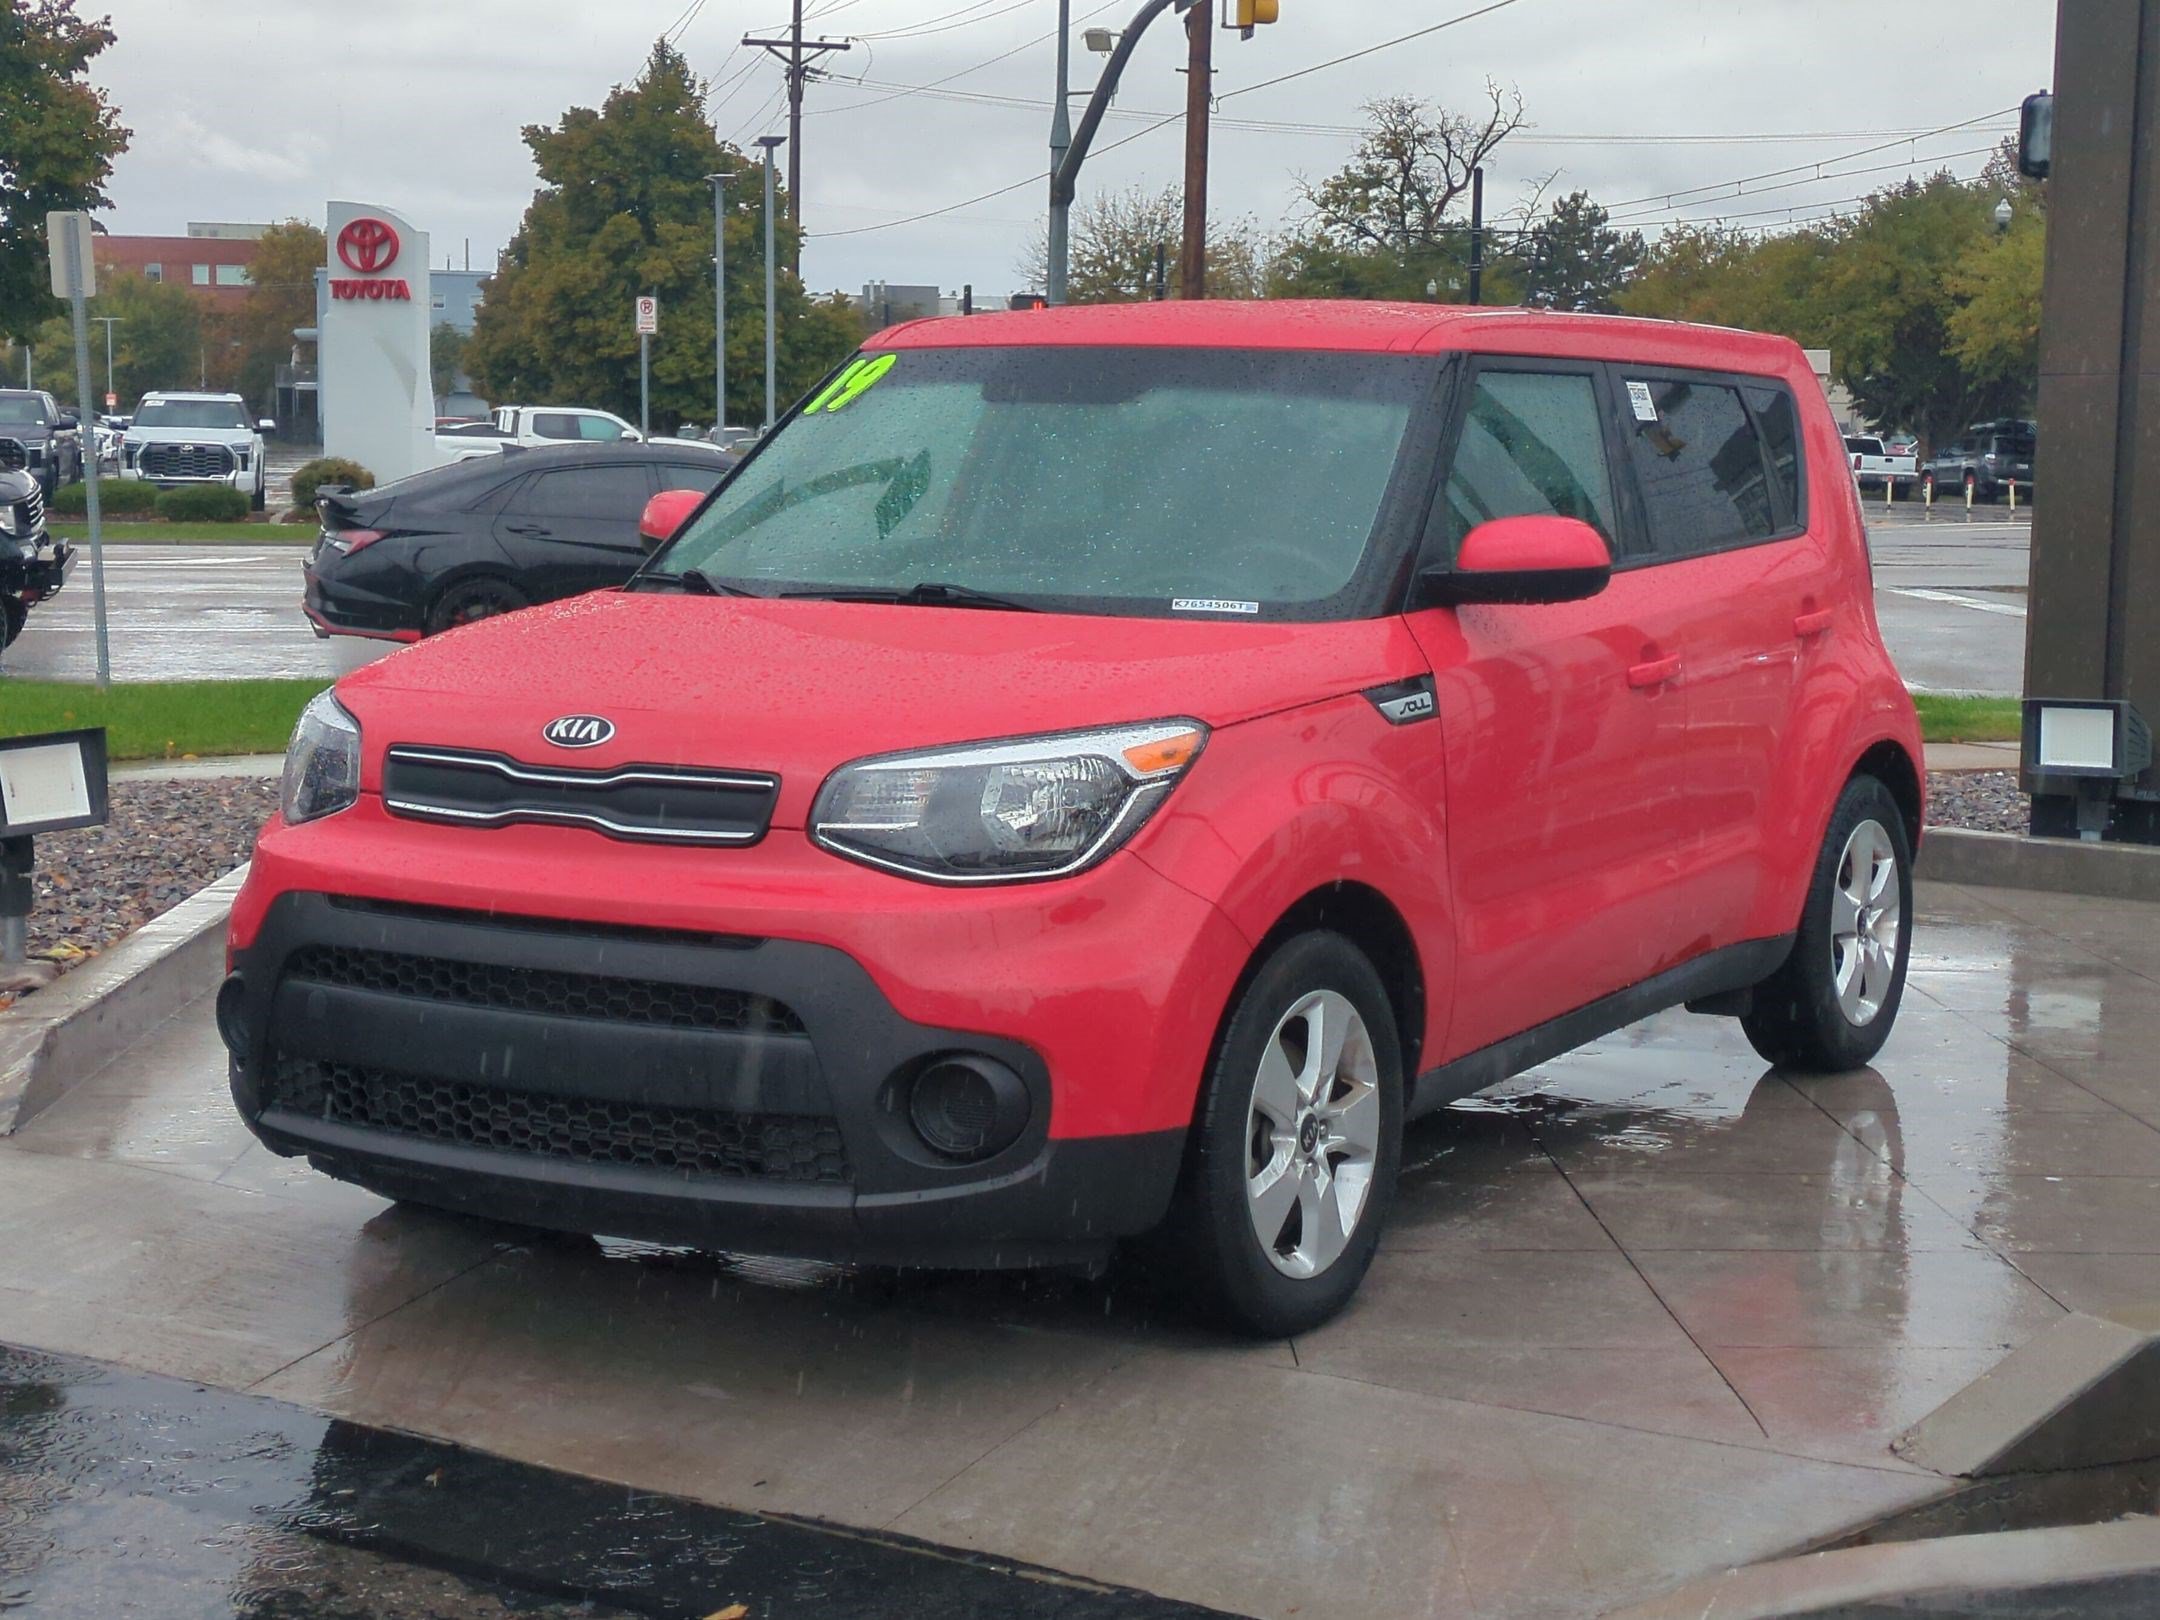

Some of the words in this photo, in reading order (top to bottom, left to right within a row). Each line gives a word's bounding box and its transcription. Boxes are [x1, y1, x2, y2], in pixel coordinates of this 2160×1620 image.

[328, 279, 411, 300] TOYOTA
[803, 354, 897, 415] 19
[550, 718, 600, 741] KIA
